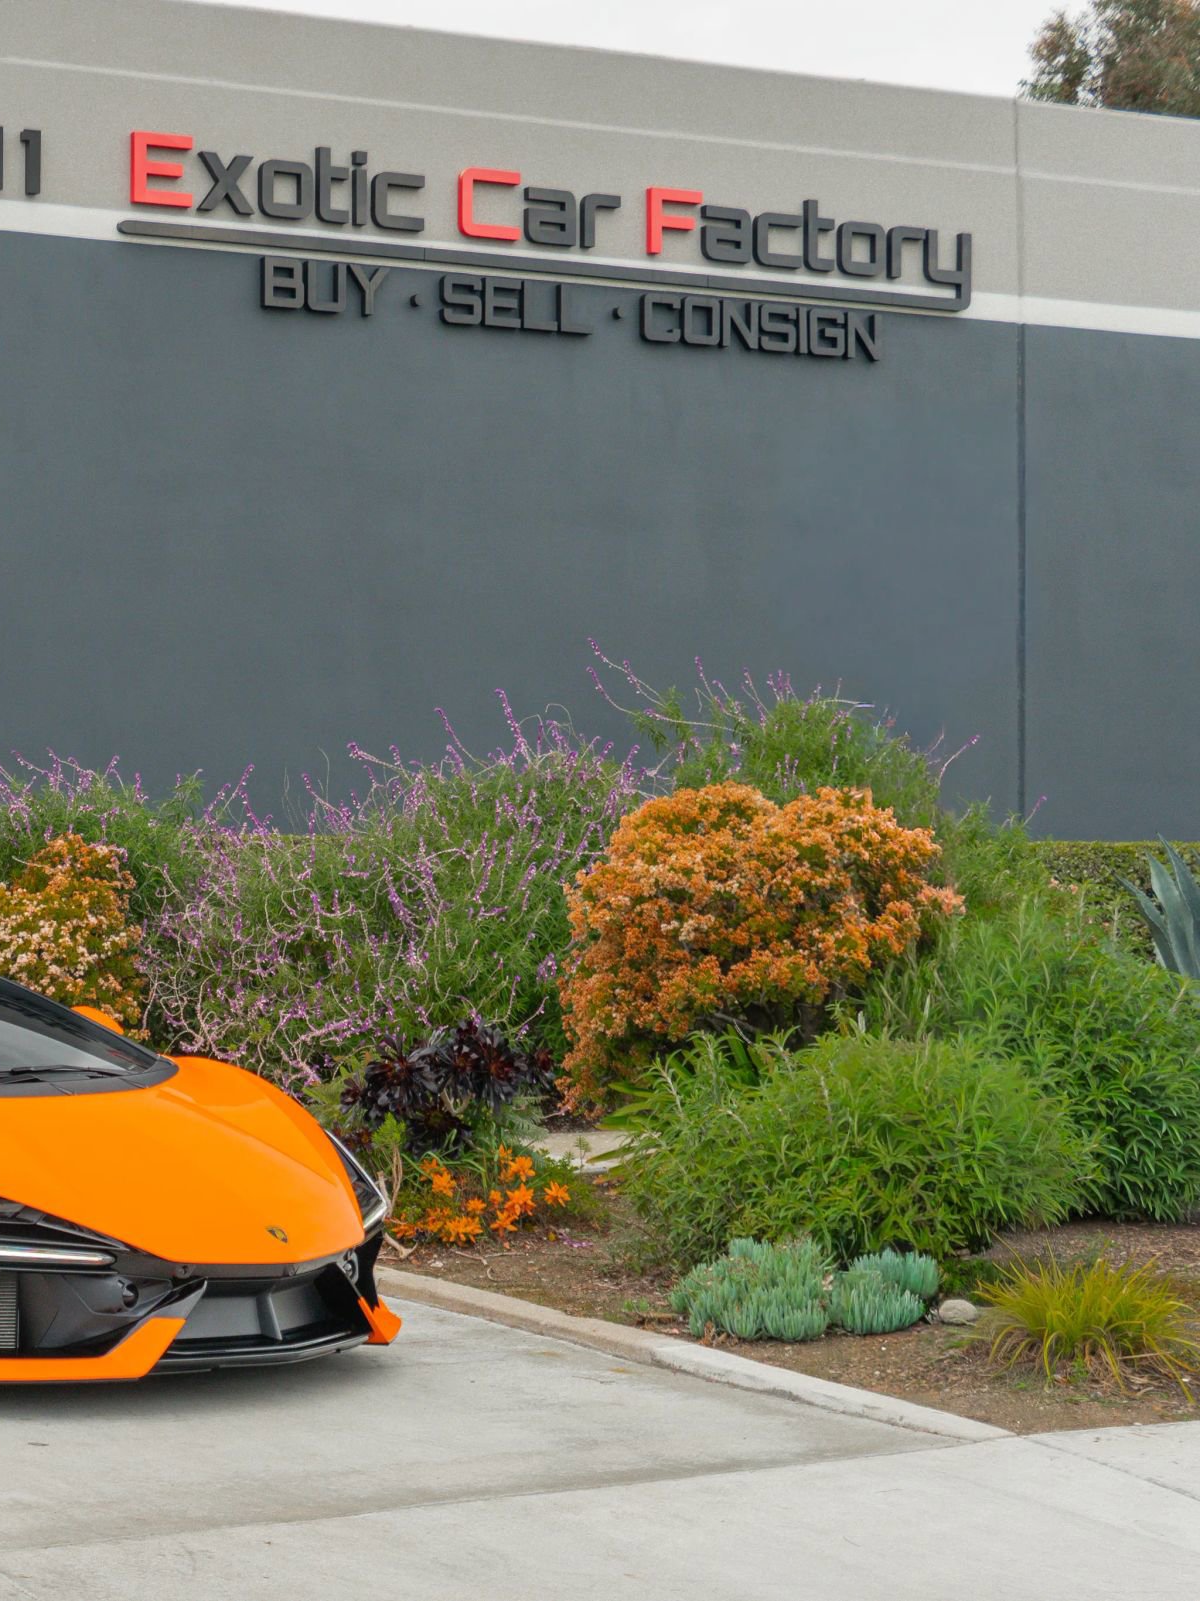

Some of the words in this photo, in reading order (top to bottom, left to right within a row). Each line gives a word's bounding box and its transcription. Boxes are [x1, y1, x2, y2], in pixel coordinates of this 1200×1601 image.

[130, 131, 425, 232] Exotic
[458, 167, 621, 248] Car
[646, 186, 972, 311] Factory
[260, 256, 389, 316] BUY
[440, 275, 592, 336] SELL
[640, 293, 882, 361] CONSIGN
